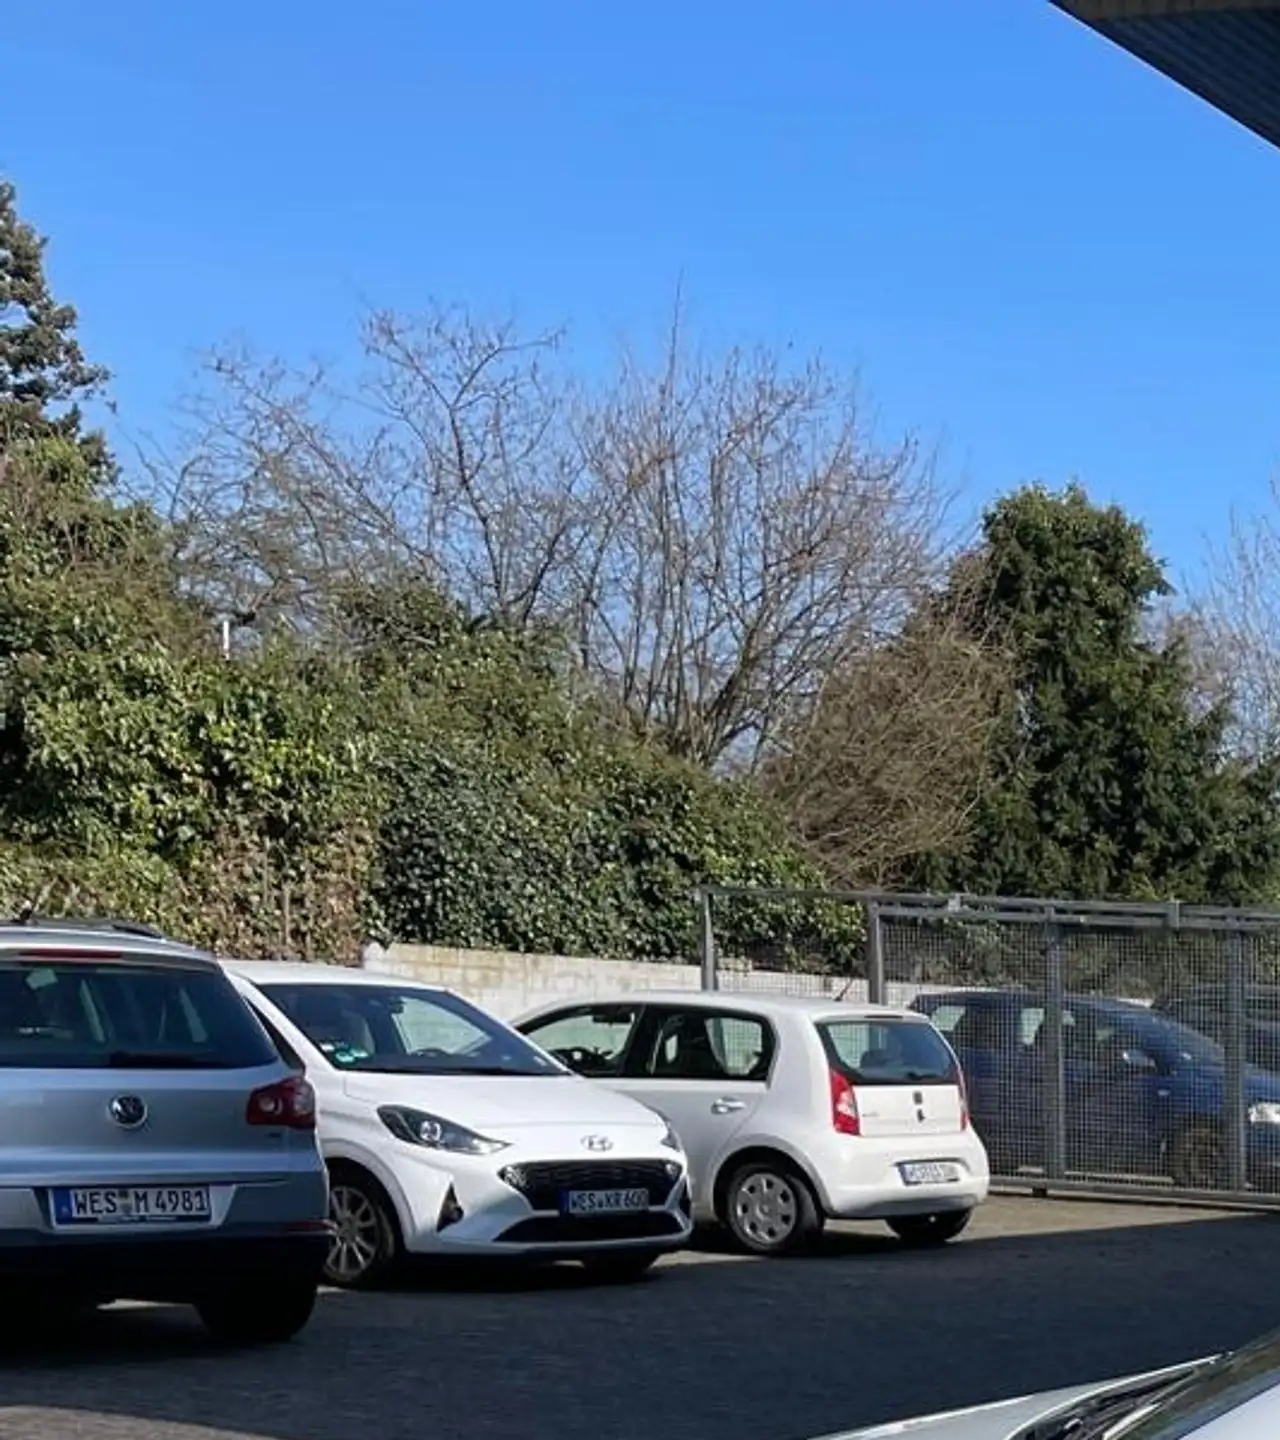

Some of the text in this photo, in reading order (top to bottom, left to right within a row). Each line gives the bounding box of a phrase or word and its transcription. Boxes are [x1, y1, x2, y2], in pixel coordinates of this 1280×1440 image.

[74, 1190, 208, 1214] WES M 4981
